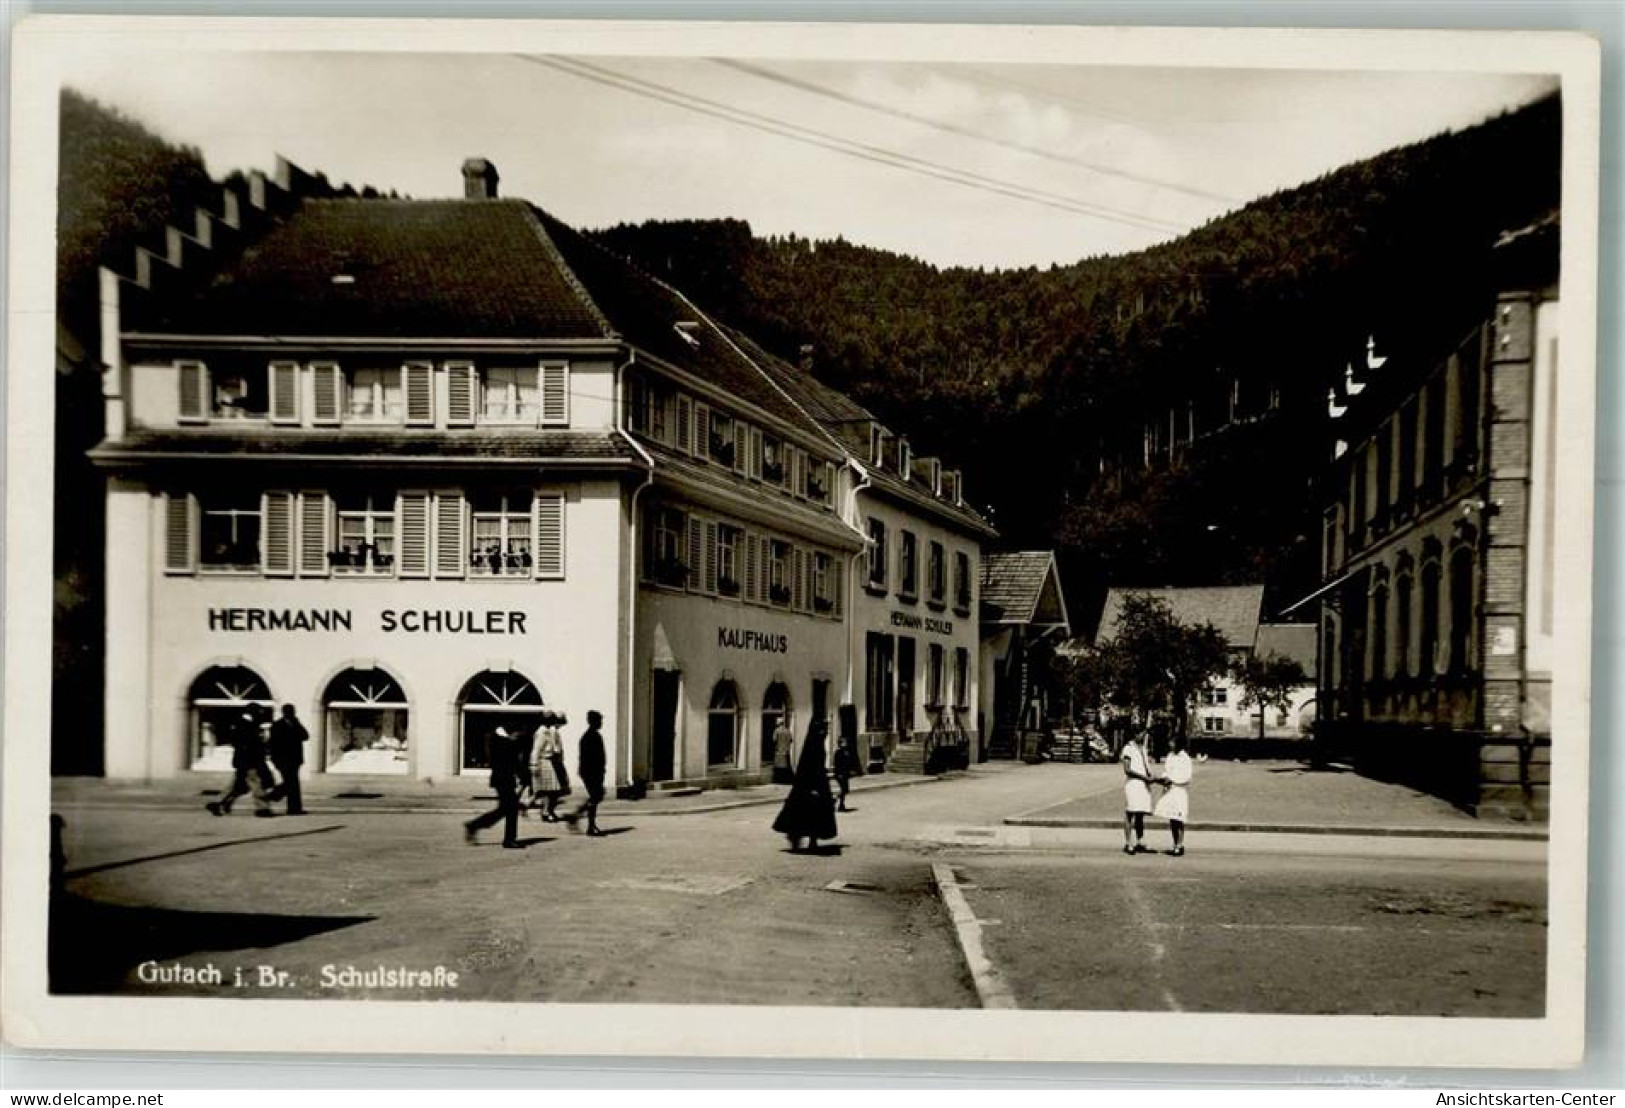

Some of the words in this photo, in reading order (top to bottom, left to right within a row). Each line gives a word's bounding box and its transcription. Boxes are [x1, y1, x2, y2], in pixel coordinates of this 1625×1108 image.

[208, 608, 352, 631] HERMANN
[380, 610, 527, 634] SCHULER
[890, 611, 922, 629] HERMANN
[925, 618, 953, 635] SCHULER
[718, 626, 788, 654] KAUFHAUS
